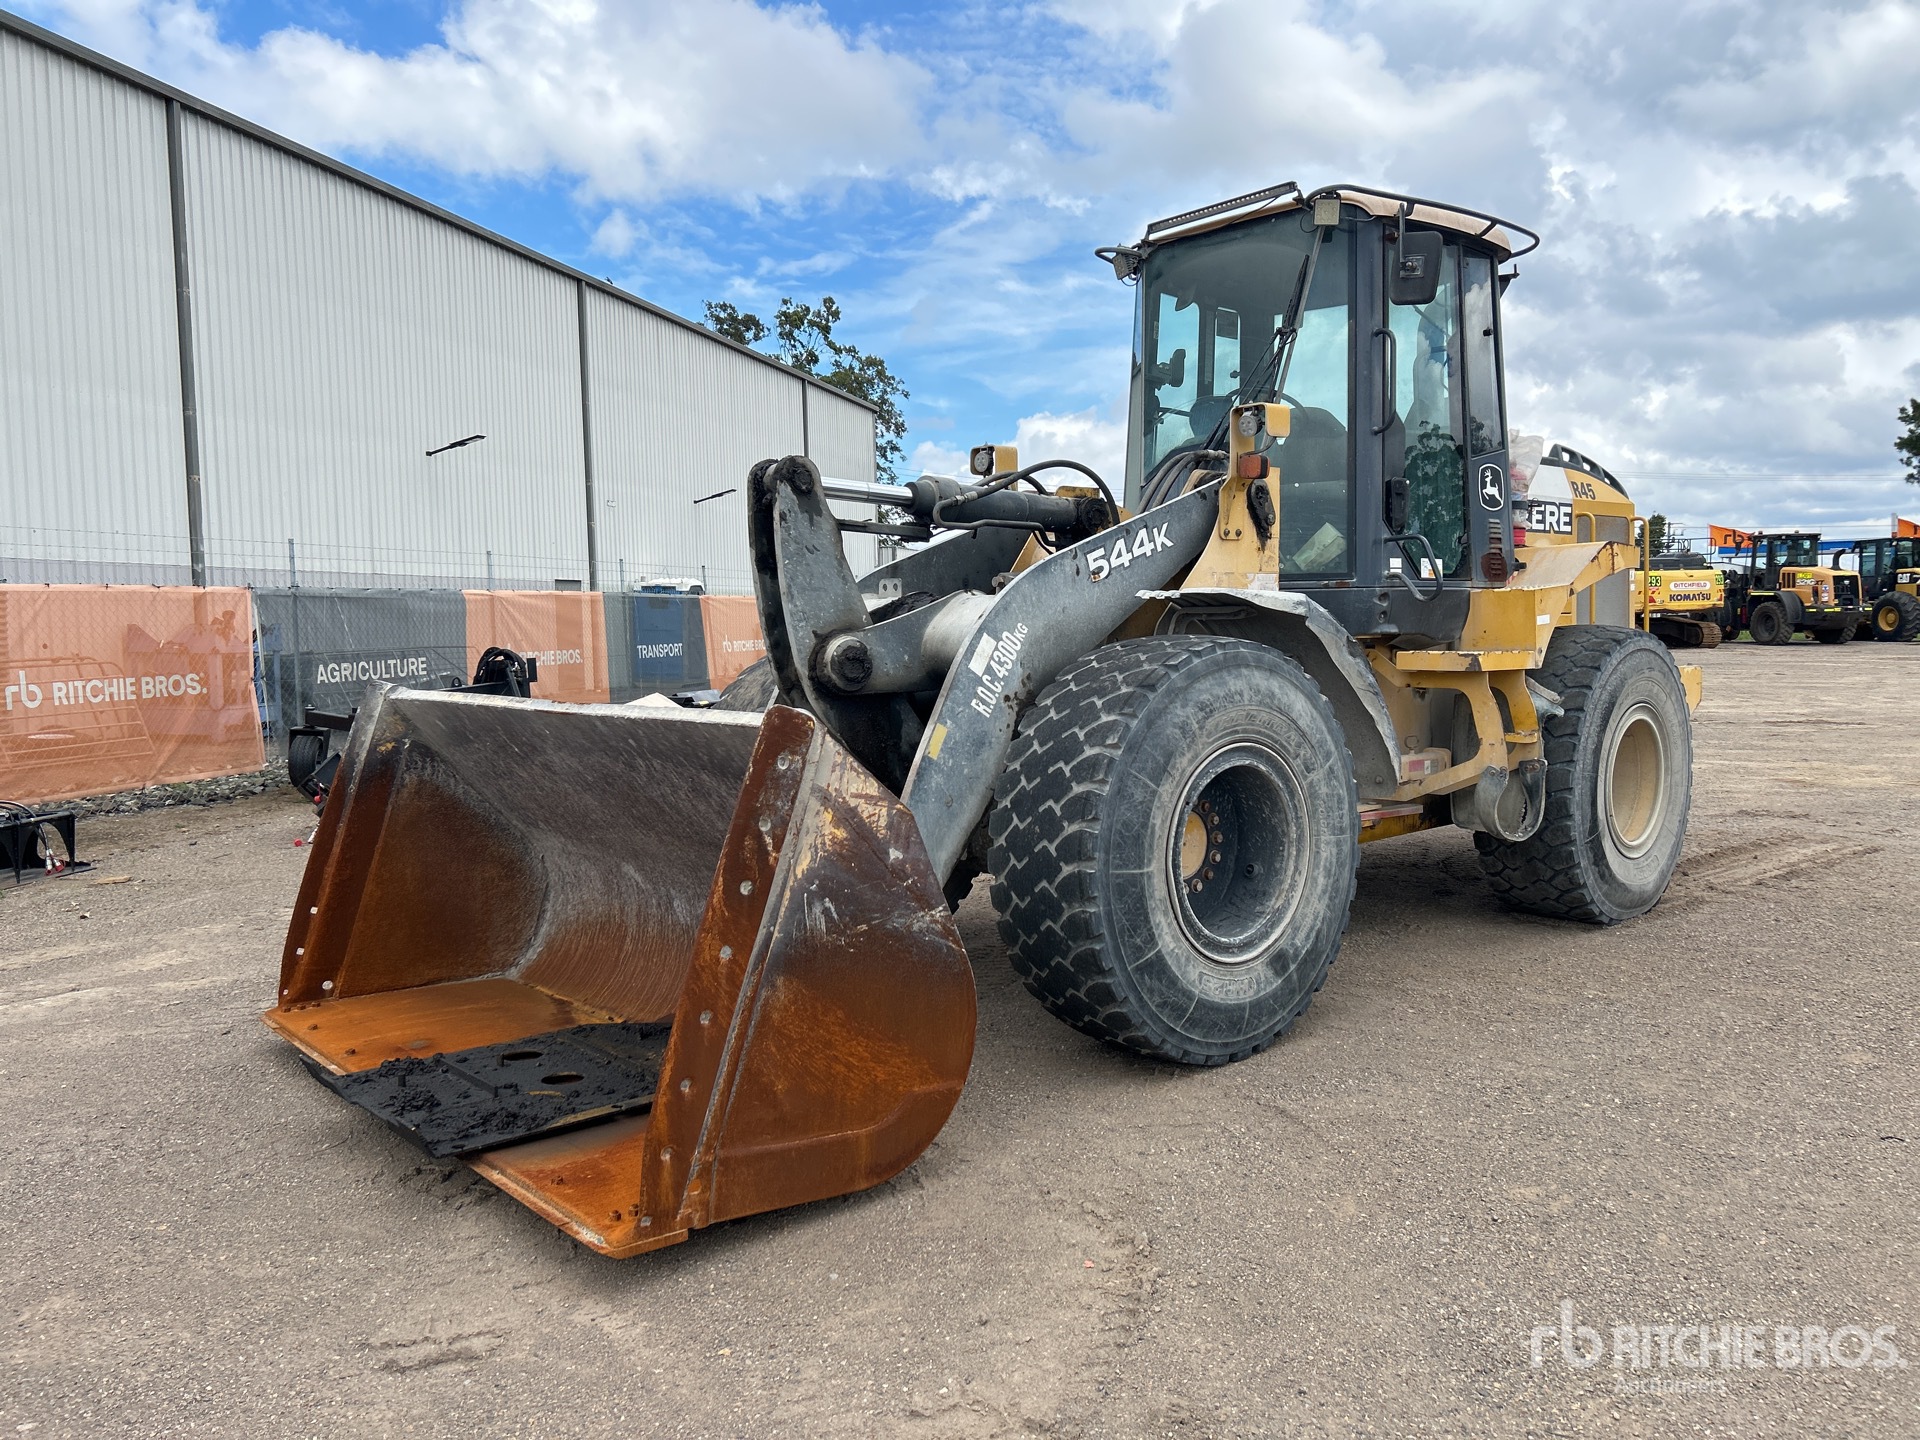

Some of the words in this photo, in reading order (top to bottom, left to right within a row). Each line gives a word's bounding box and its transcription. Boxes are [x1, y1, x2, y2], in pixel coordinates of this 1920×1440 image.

[1571, 481, 1596, 500] R45
[1526, 504, 1571, 532] ERE
[1086, 521, 1174, 582] 544K
[1897, 574, 1911, 583] CAT
[1669, 592, 1711, 602] KOMATSU
[636, 642, 683, 659] TRANSPORT
[733, 640, 754, 652] RITCHIE
[556, 649, 583, 665] BROS.
[317, 657, 427, 684] AGRICULTURE
[5, 670, 43, 711] rb
[52, 677, 137, 706] RITCHIE
[141, 673, 208, 699] BROS.
